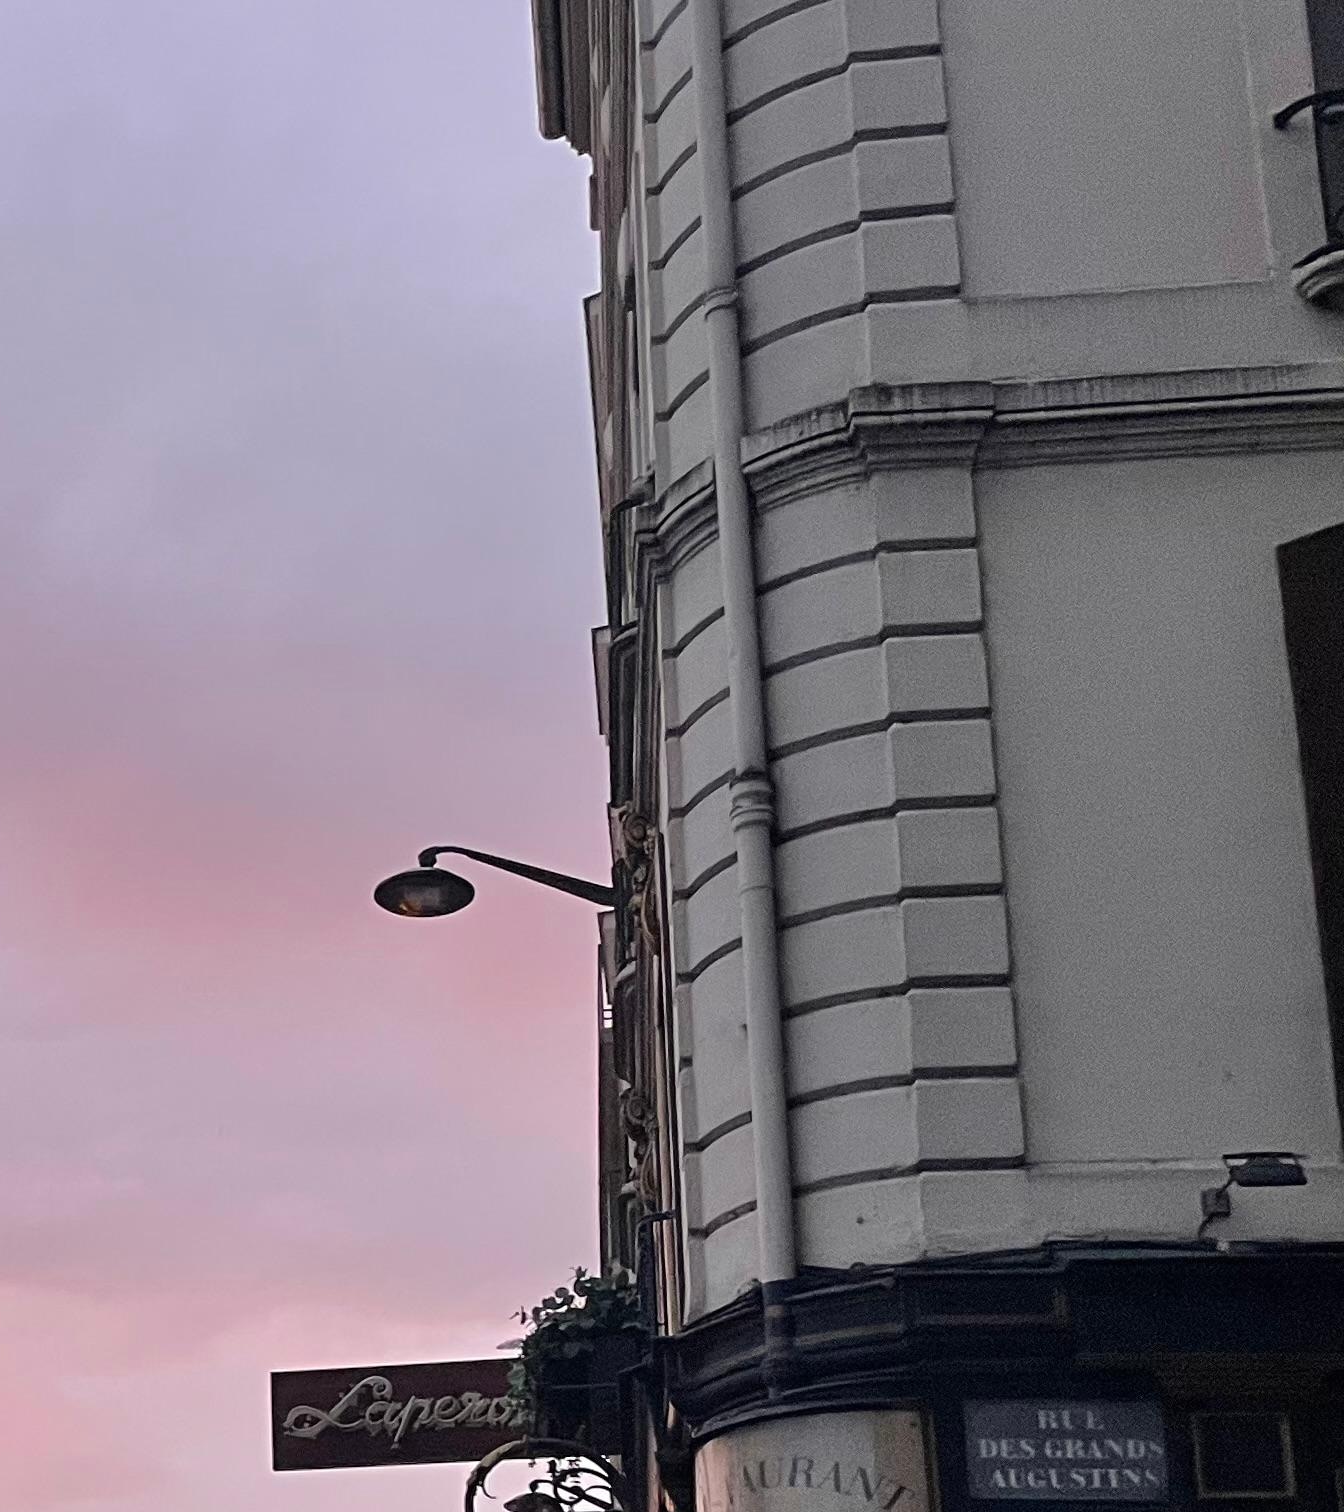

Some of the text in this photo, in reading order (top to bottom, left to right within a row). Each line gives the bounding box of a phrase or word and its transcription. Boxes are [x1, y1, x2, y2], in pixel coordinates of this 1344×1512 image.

[1037, 1409, 1105, 1431] RUE
[978, 1438, 1163, 1460] DES GRANDS
[991, 1468, 1160, 1490] AUGUSTINS
